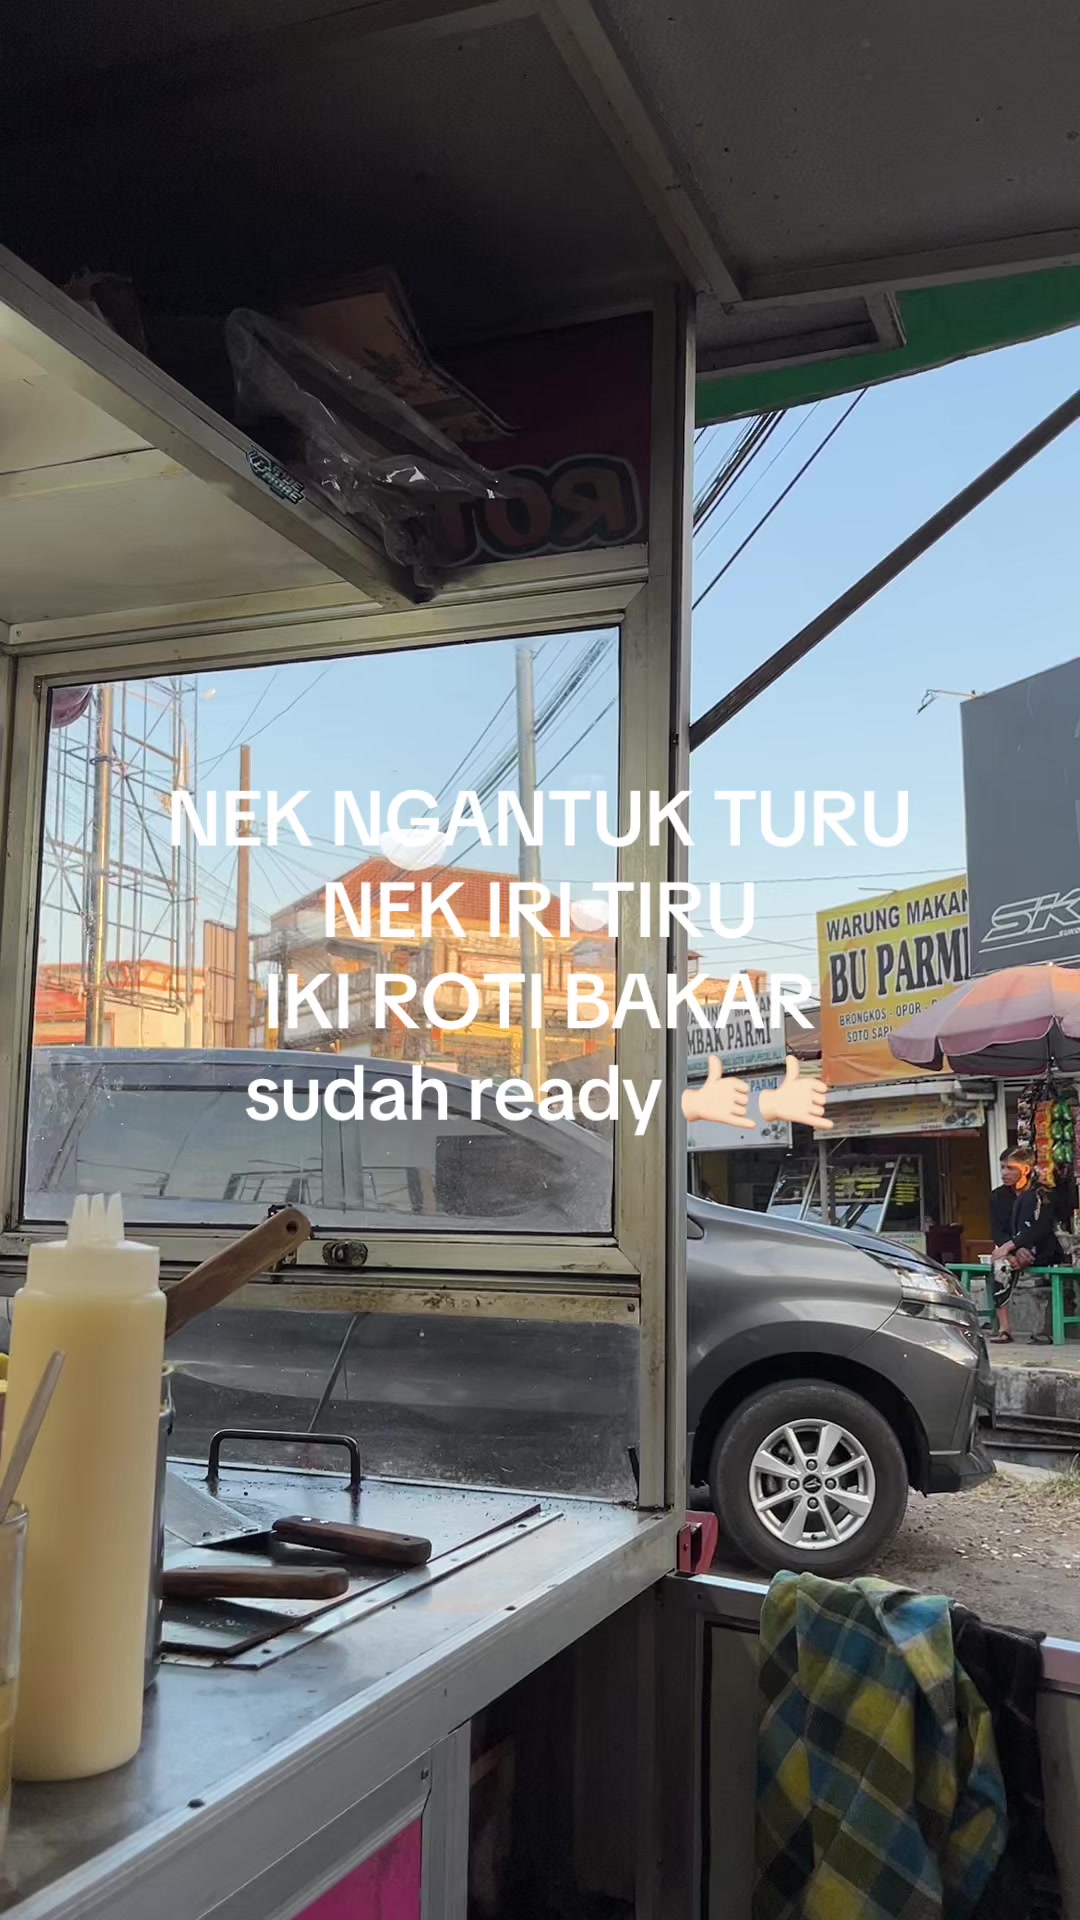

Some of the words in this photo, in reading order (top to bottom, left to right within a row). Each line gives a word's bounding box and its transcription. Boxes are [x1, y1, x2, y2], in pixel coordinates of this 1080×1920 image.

[827, 905, 900, 942] WARUNG
[829, 949, 867, 1004] BU
[876, 926, 971, 996] PARMI
[839, 1009, 887, 1026] BRONGKOS
[896, 1002, 921, 1017] OPOR
[847, 1031, 869, 1043] SOTO
